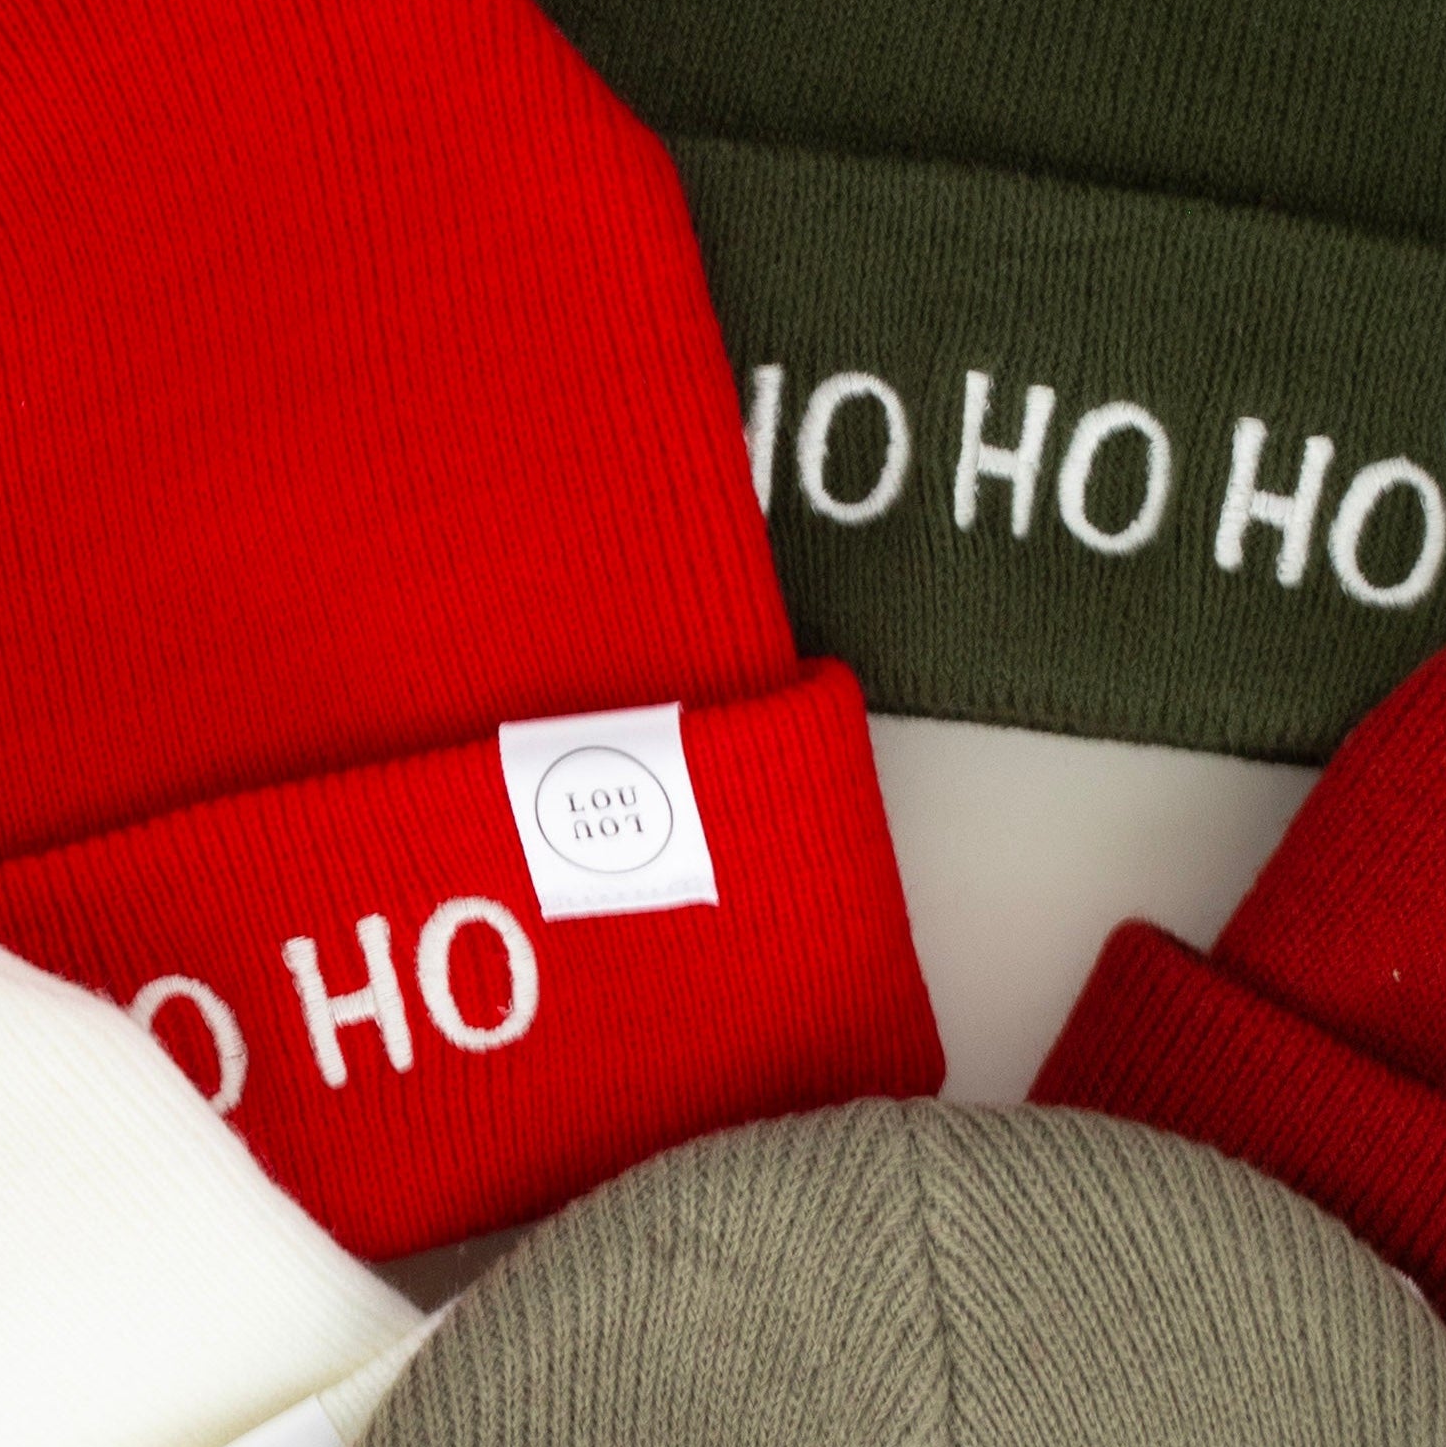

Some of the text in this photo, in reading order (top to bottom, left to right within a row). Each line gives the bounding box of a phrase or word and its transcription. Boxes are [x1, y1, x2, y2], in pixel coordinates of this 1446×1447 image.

[953, 370, 1173, 555] HO
[566, 786, 637, 813] LOU
[280, 895, 540, 1090] HO
